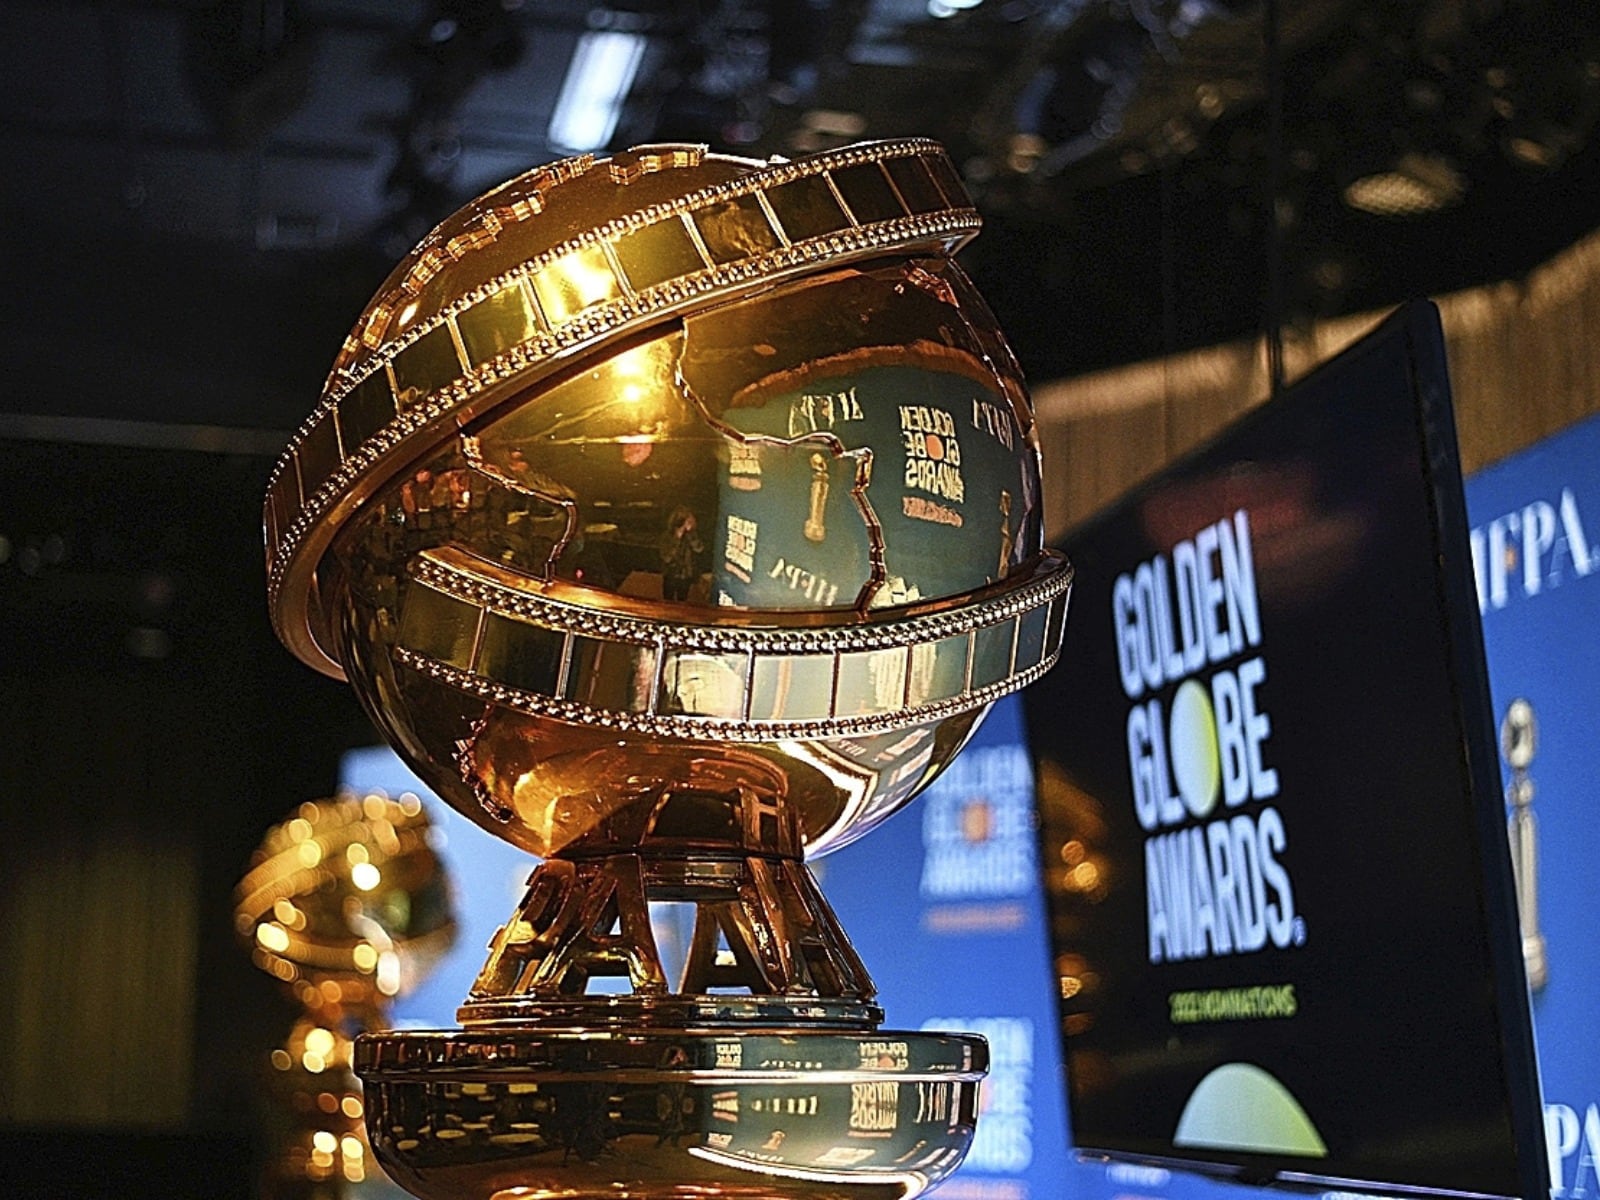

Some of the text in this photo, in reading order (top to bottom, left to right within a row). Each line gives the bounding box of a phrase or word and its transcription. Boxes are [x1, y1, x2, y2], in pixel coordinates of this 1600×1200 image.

[1112, 507, 1263, 700] GOLDEN
[1127, 656, 1281, 832] GLOBE
[1144, 806, 1295, 966] AWARDS
